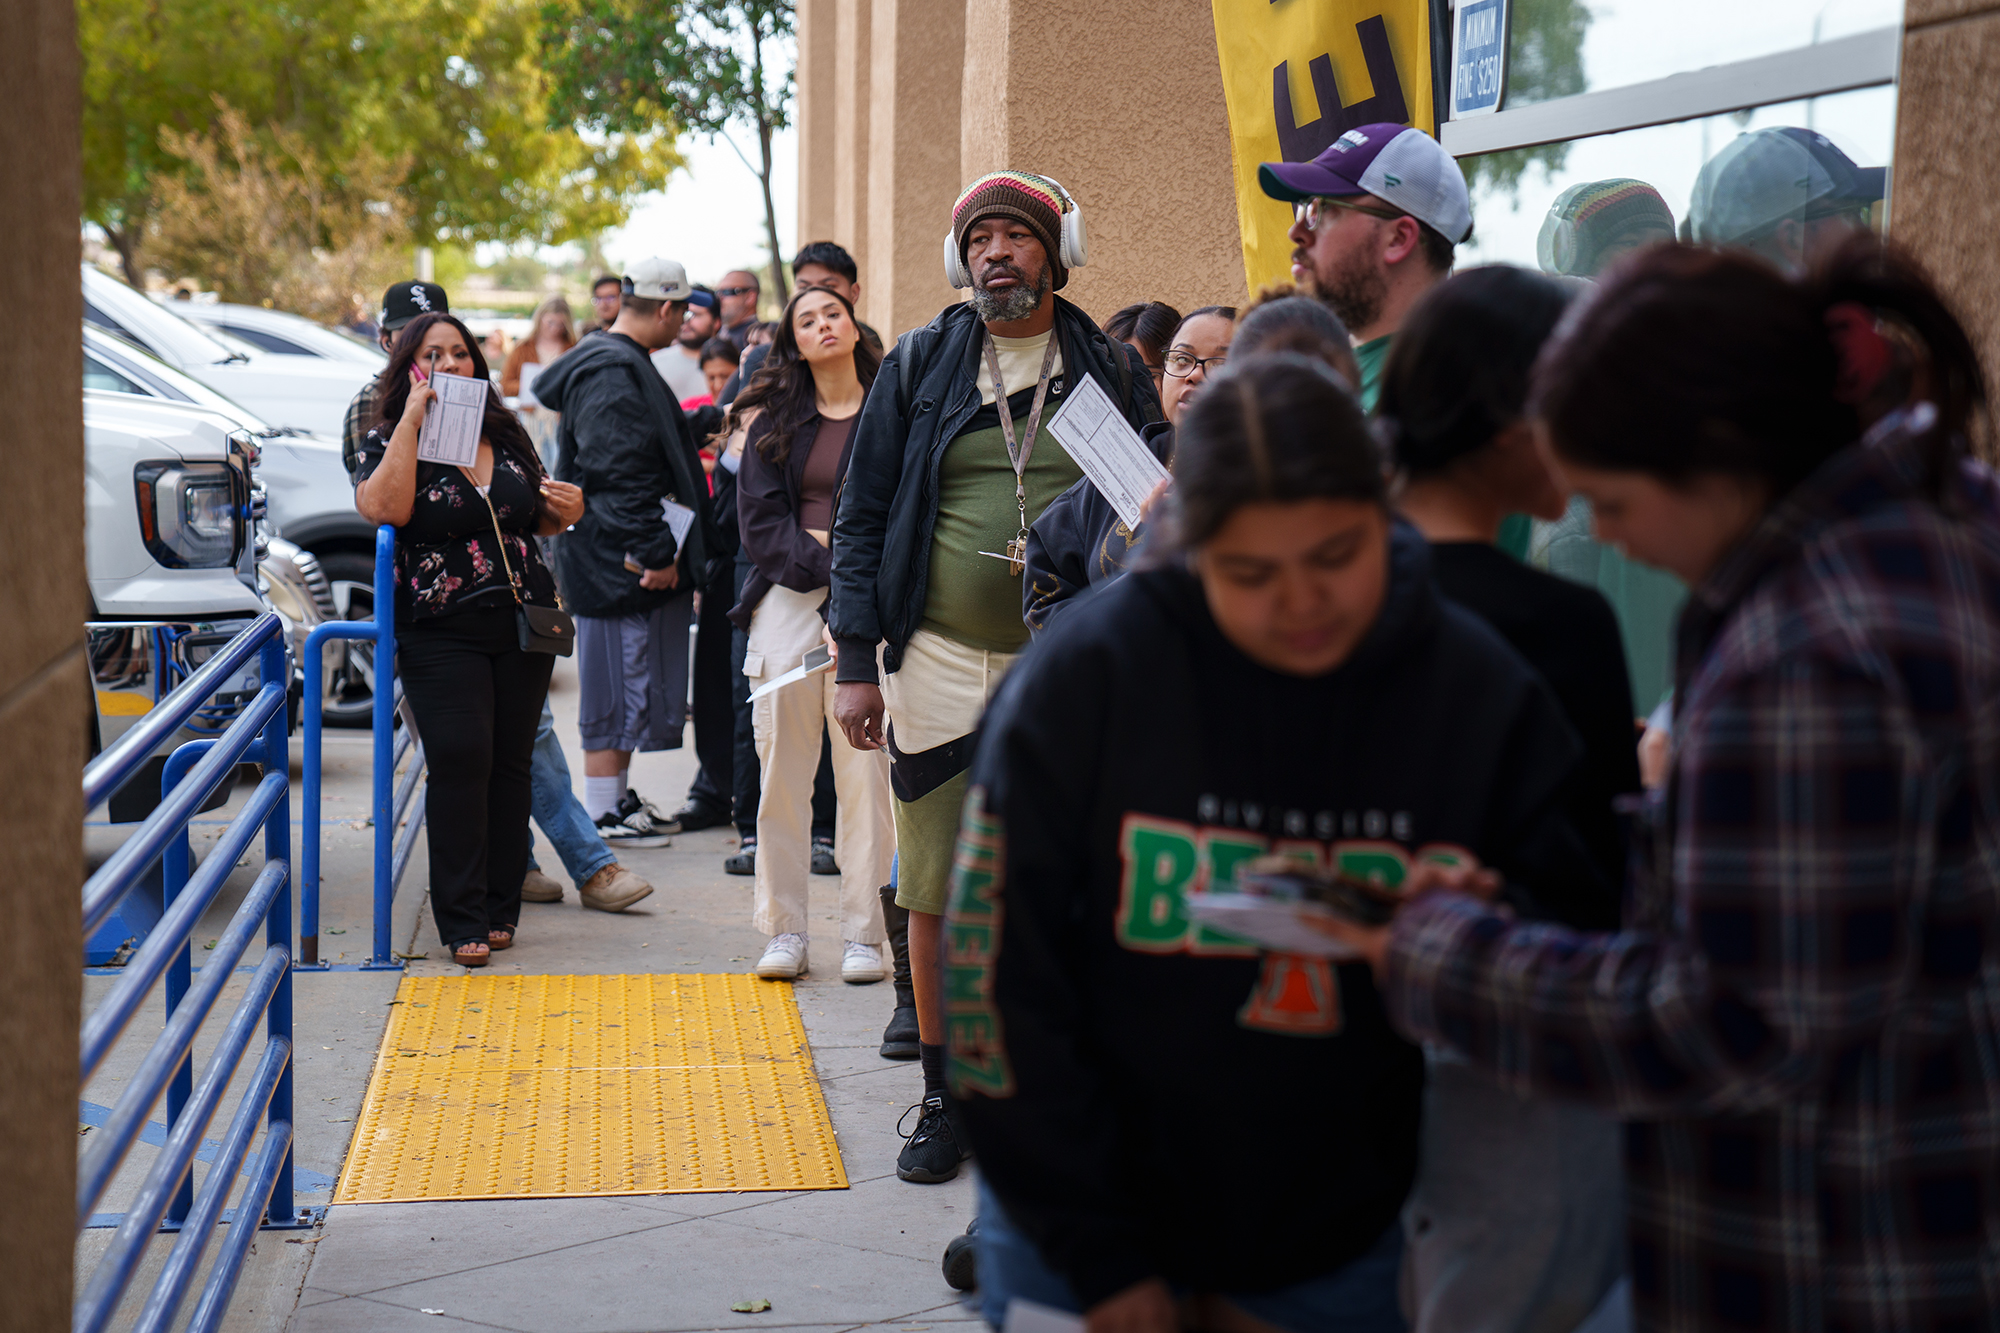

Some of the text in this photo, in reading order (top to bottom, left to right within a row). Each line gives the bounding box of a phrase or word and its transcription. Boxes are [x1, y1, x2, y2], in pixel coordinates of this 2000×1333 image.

[1465, 6, 1497, 50] MINIMUM
[1458, 54, 1499, 100] FINE $250
[1197, 792, 1414, 841] RIVRSIDE
[945, 784, 1017, 1098] JIMENEZ
